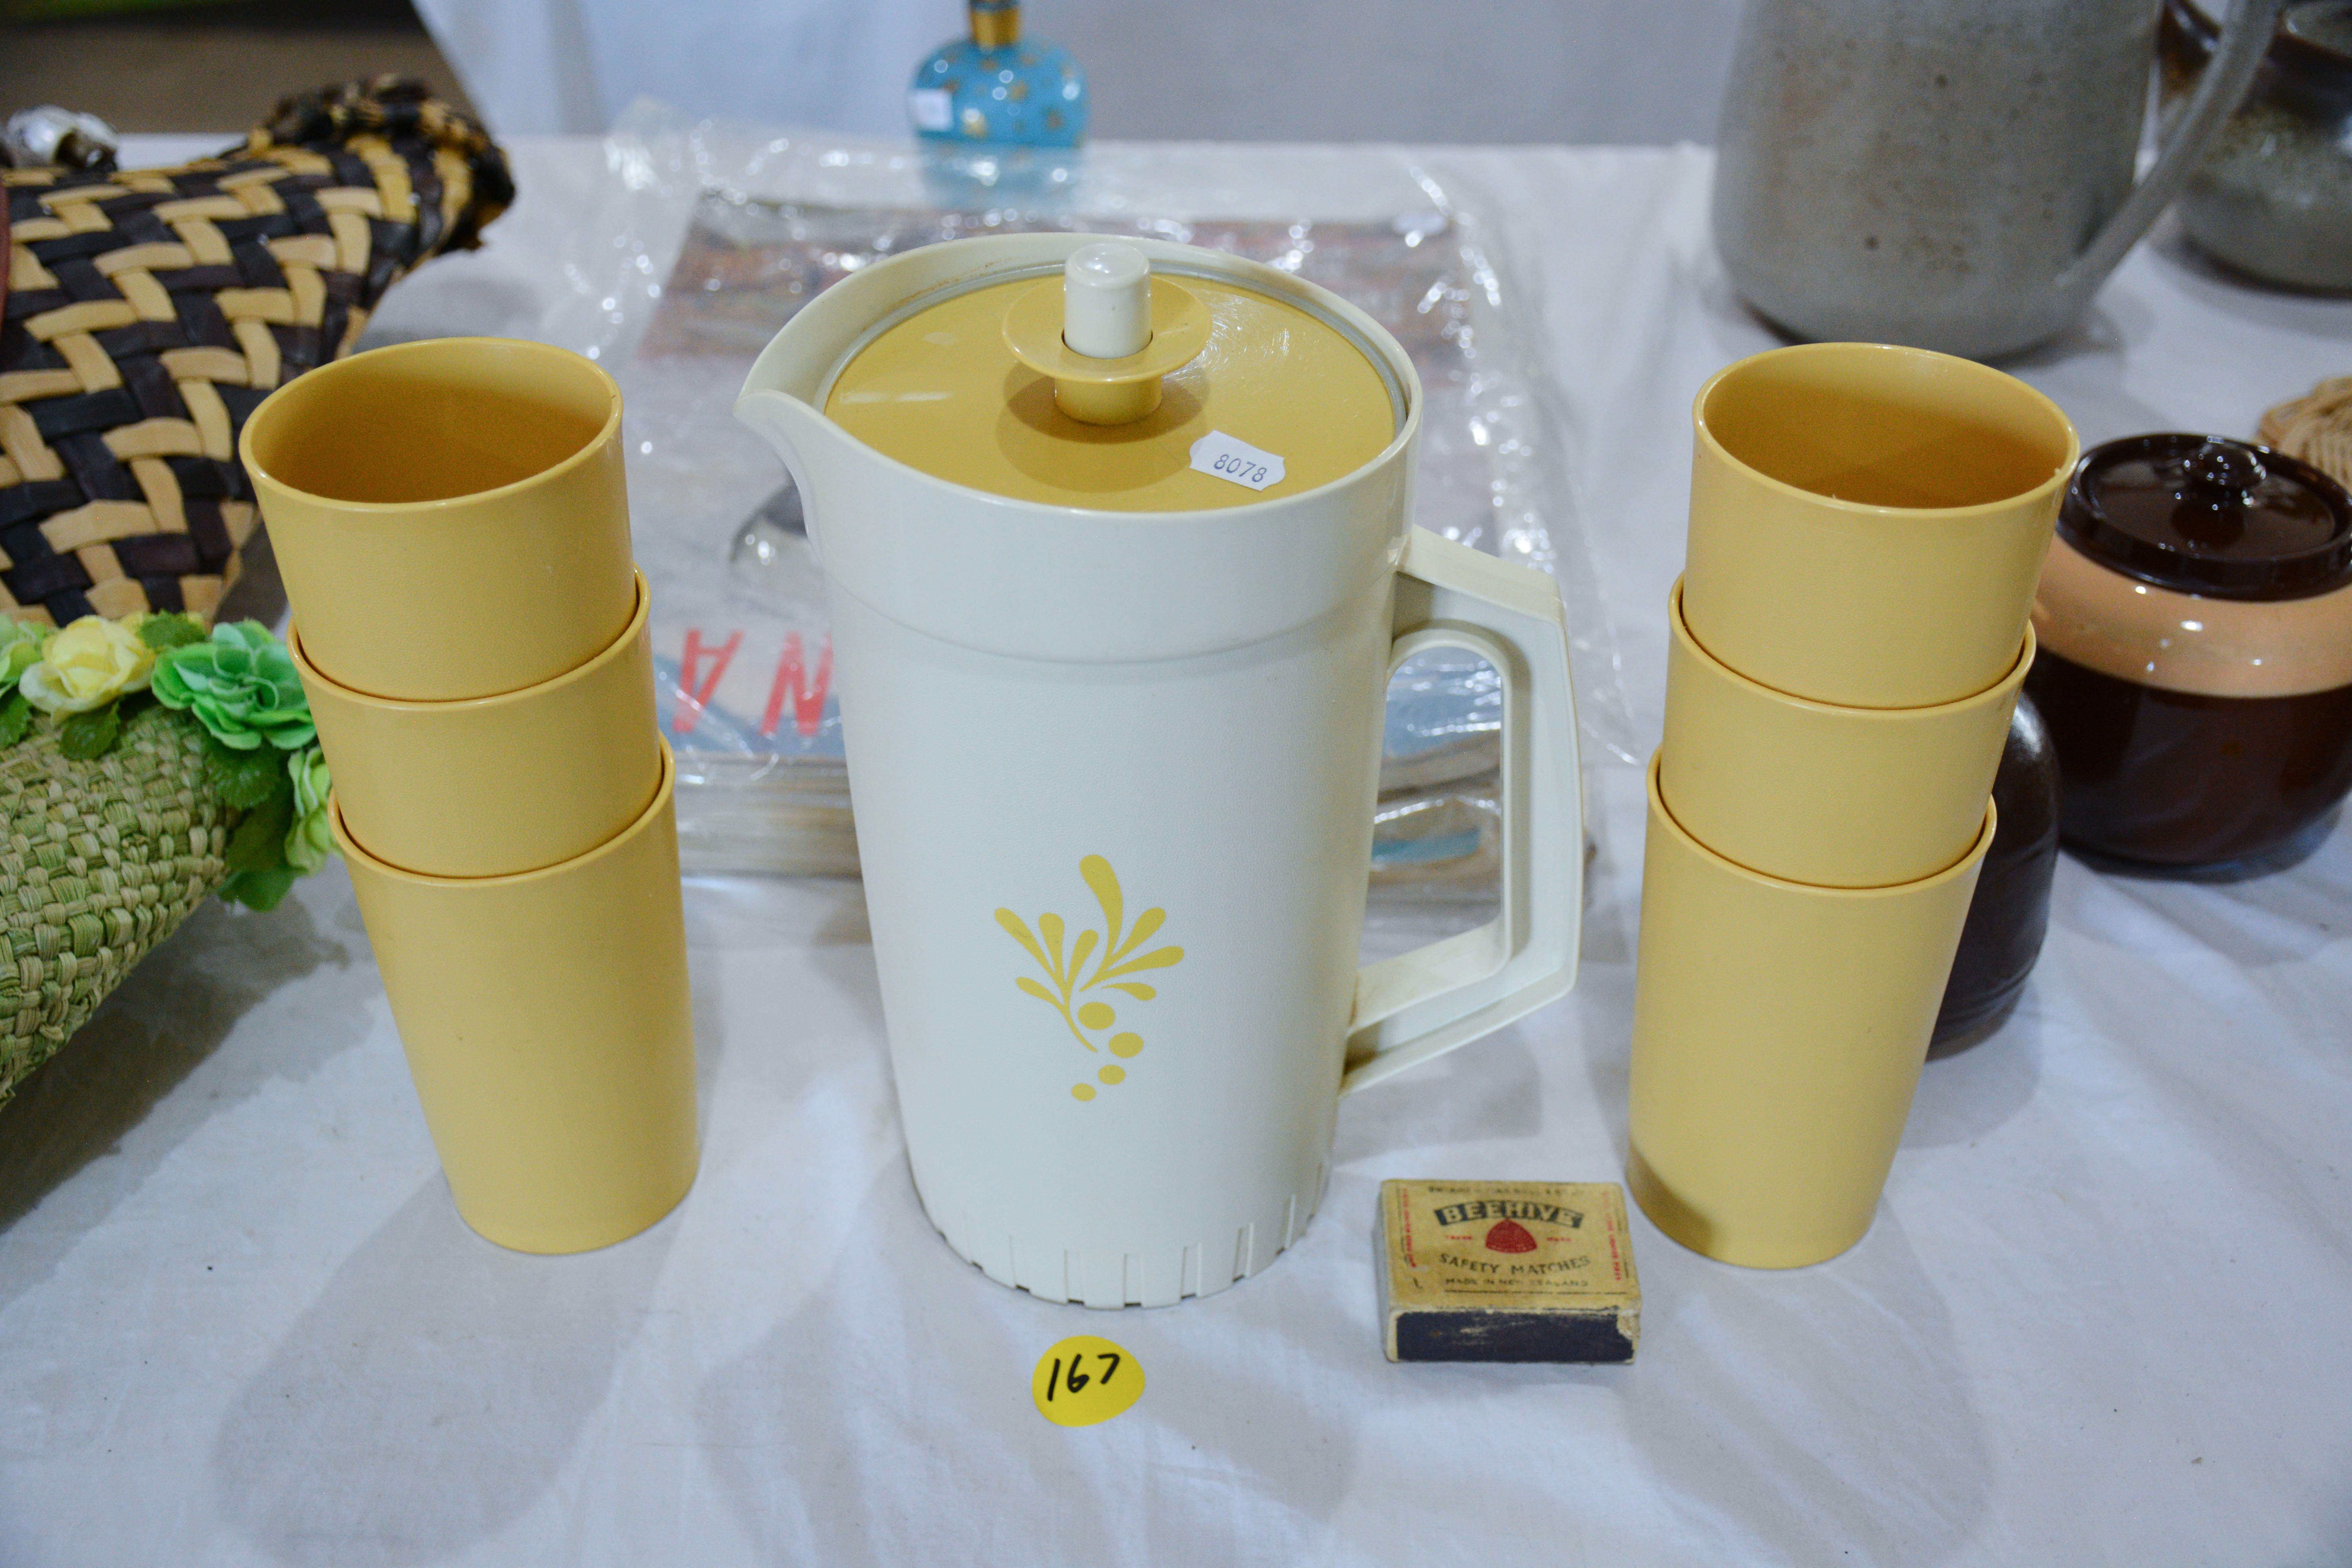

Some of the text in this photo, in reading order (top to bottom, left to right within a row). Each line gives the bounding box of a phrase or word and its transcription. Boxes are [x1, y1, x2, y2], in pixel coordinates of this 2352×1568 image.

[1214, 454, 1267, 483] 8078
[1442, 1200, 1576, 1227] BEEHIVE
[1439, 1252, 1591, 1275] SAFETY MATCHES
[1047, 1353, 1120, 1402] 167
